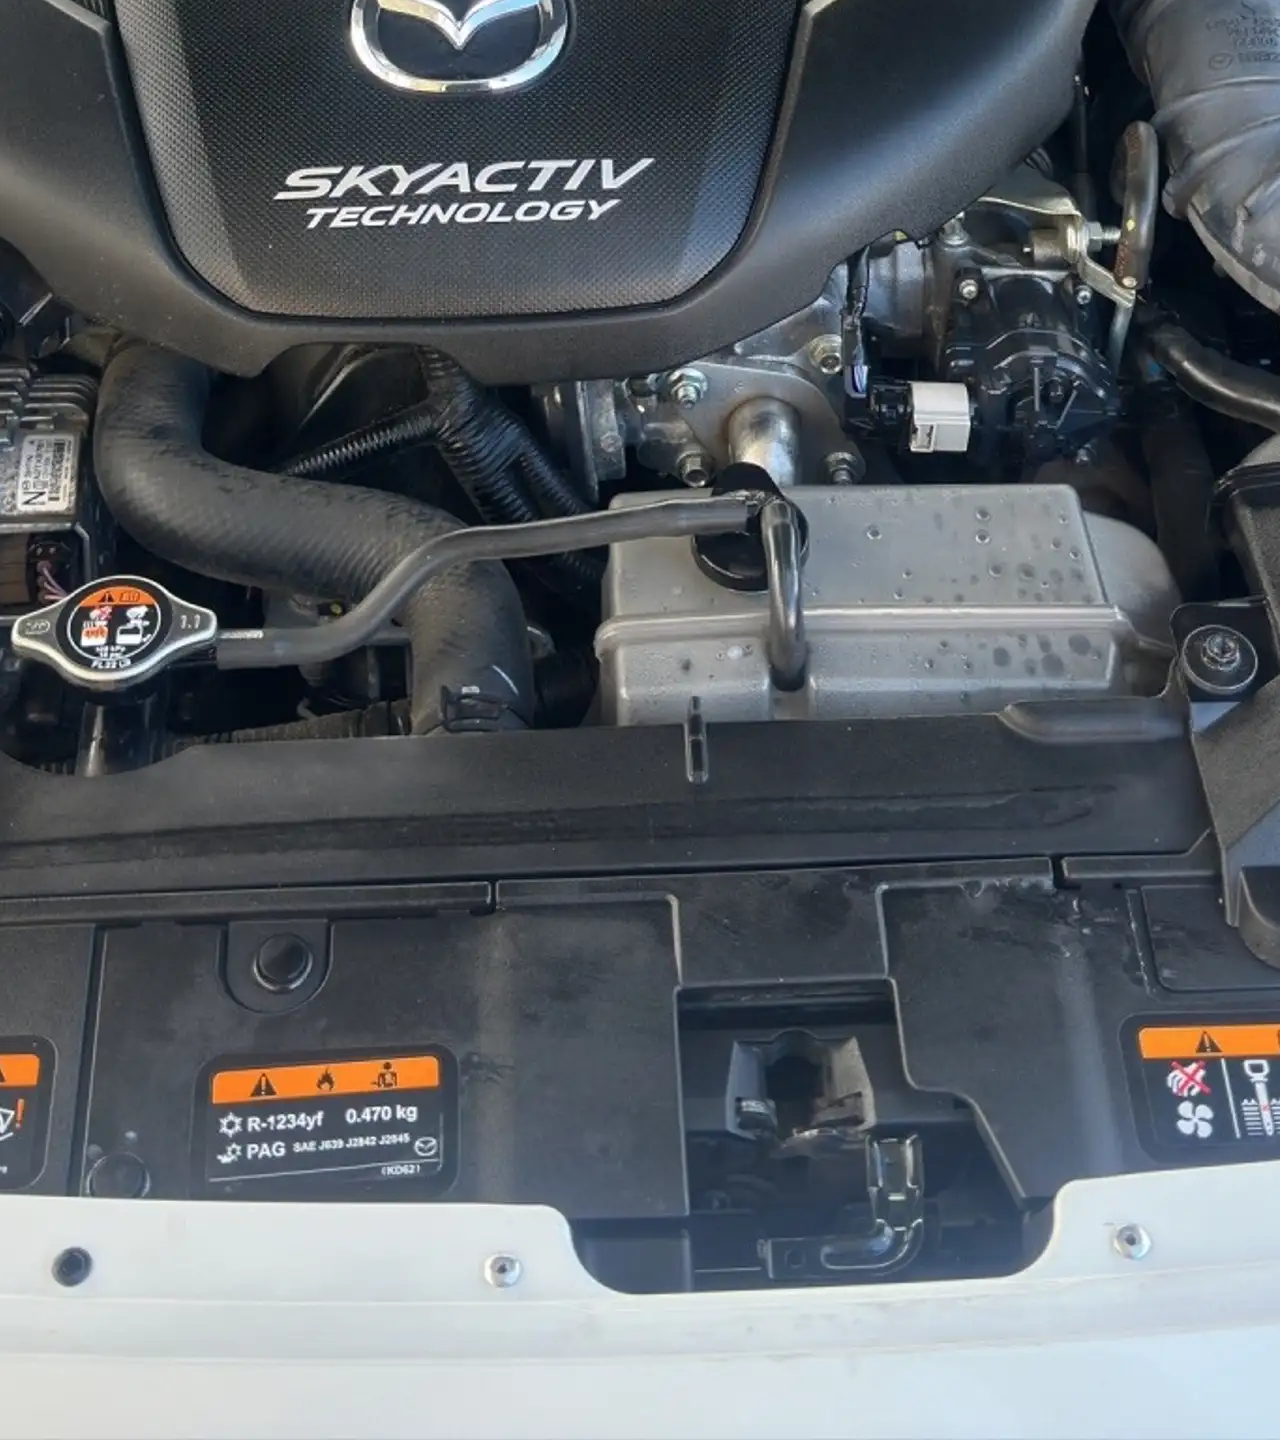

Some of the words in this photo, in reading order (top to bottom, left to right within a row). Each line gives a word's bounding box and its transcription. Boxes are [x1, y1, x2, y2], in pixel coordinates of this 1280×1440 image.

[273, 158, 655, 200] SKYACTIV
[305, 198, 621, 229] TECHNOLOGY
[247, 1111, 324, 1132] R-1234yf
[345, 1107, 392, 1124] 0.470
[395, 1105, 418, 1122] kg
[246, 1141, 286, 1159] PAG
[293, 1140, 317, 1153] SAE
